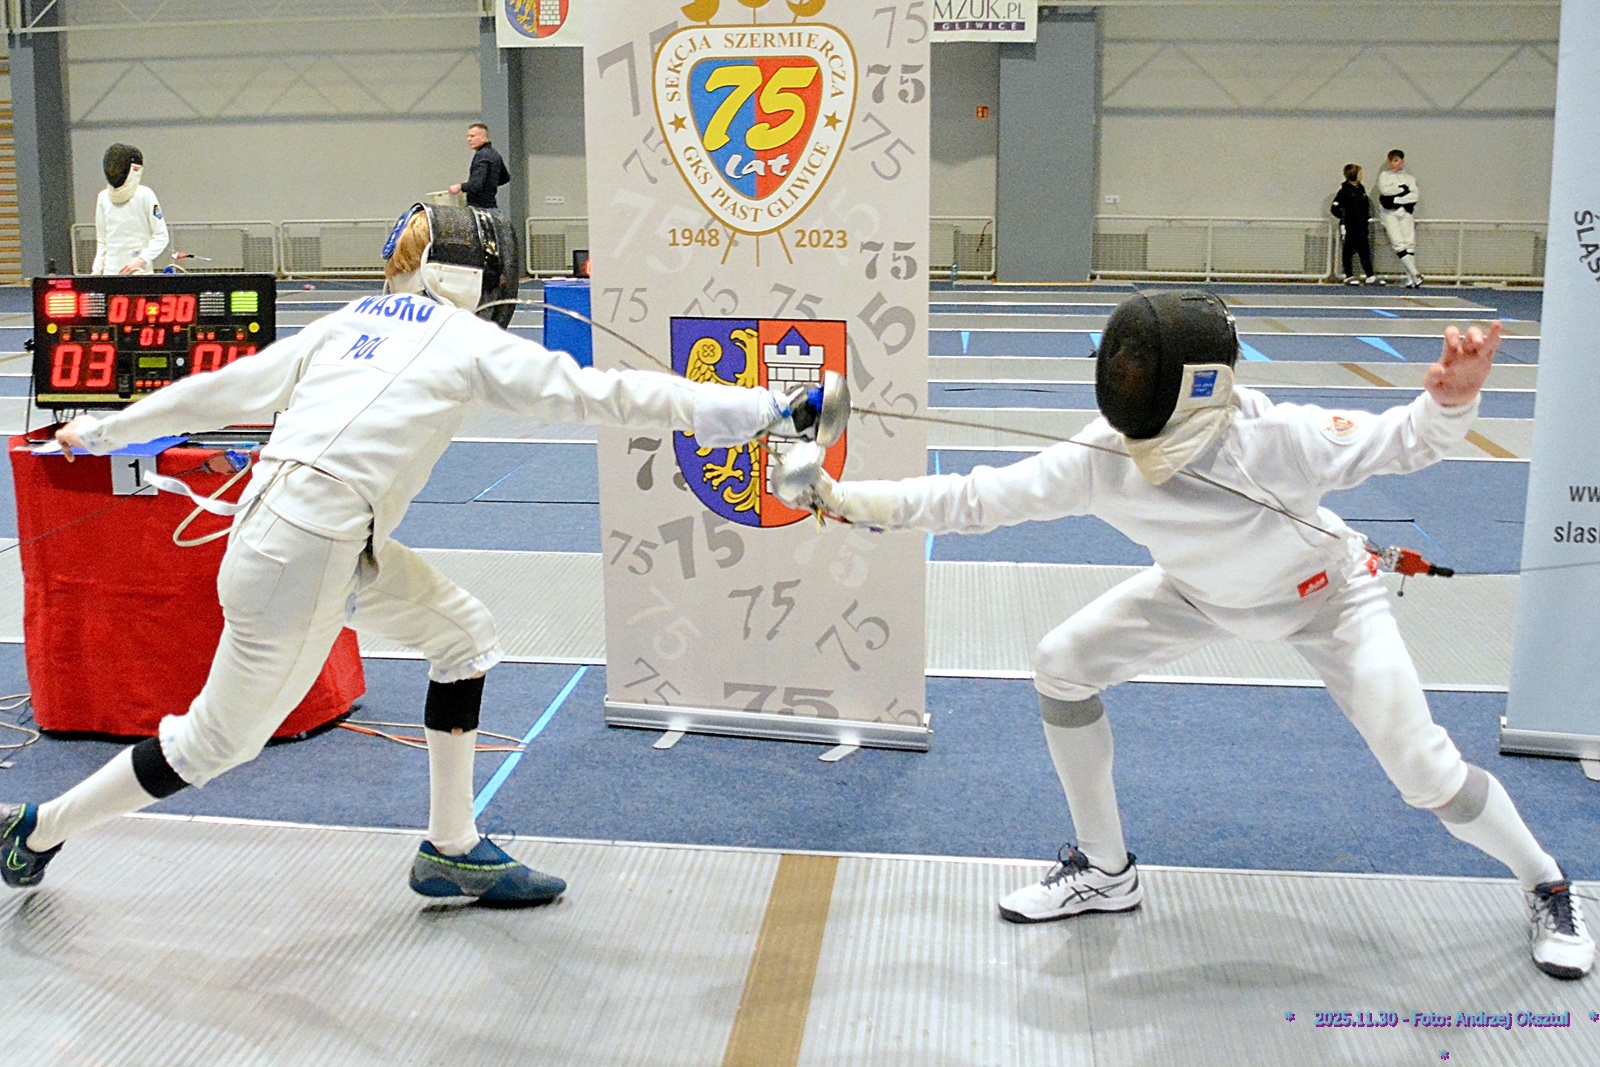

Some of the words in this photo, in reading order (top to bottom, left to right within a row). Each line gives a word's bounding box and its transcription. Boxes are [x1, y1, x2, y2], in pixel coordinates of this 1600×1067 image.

[873, 2, 928, 48] 75
[942, 22, 1017, 30] GLIWICE
[666, 35, 712, 102] SEKCJA
[724, 32, 846, 99] SZERMIERCZA
[866, 63, 926, 104] 75
[703, 65, 819, 151] 75
[725, 153, 790, 179] lat
[850, 112, 915, 181] 75
[683, 145, 712, 186] GKS
[711, 186, 763, 223] PIAST
[767, 141, 831, 218] GLIWICE
[668, 228, 720, 247] 1948
[795, 229, 848, 249] 2023
[859, 241, 918, 280] 75
[602, 287, 648, 323] 75
[139, 327, 165, 346] 01
[340, 334, 389, 359] POL
[52, 344, 115, 387] 03
[128, 458, 141, 487] 1
[609, 530, 658, 575] 75
[657, 511, 745, 580] 75
[1554, 521, 1600, 543] slas
[728, 579, 801, 640] 75
[815, 600, 890, 671] 75
